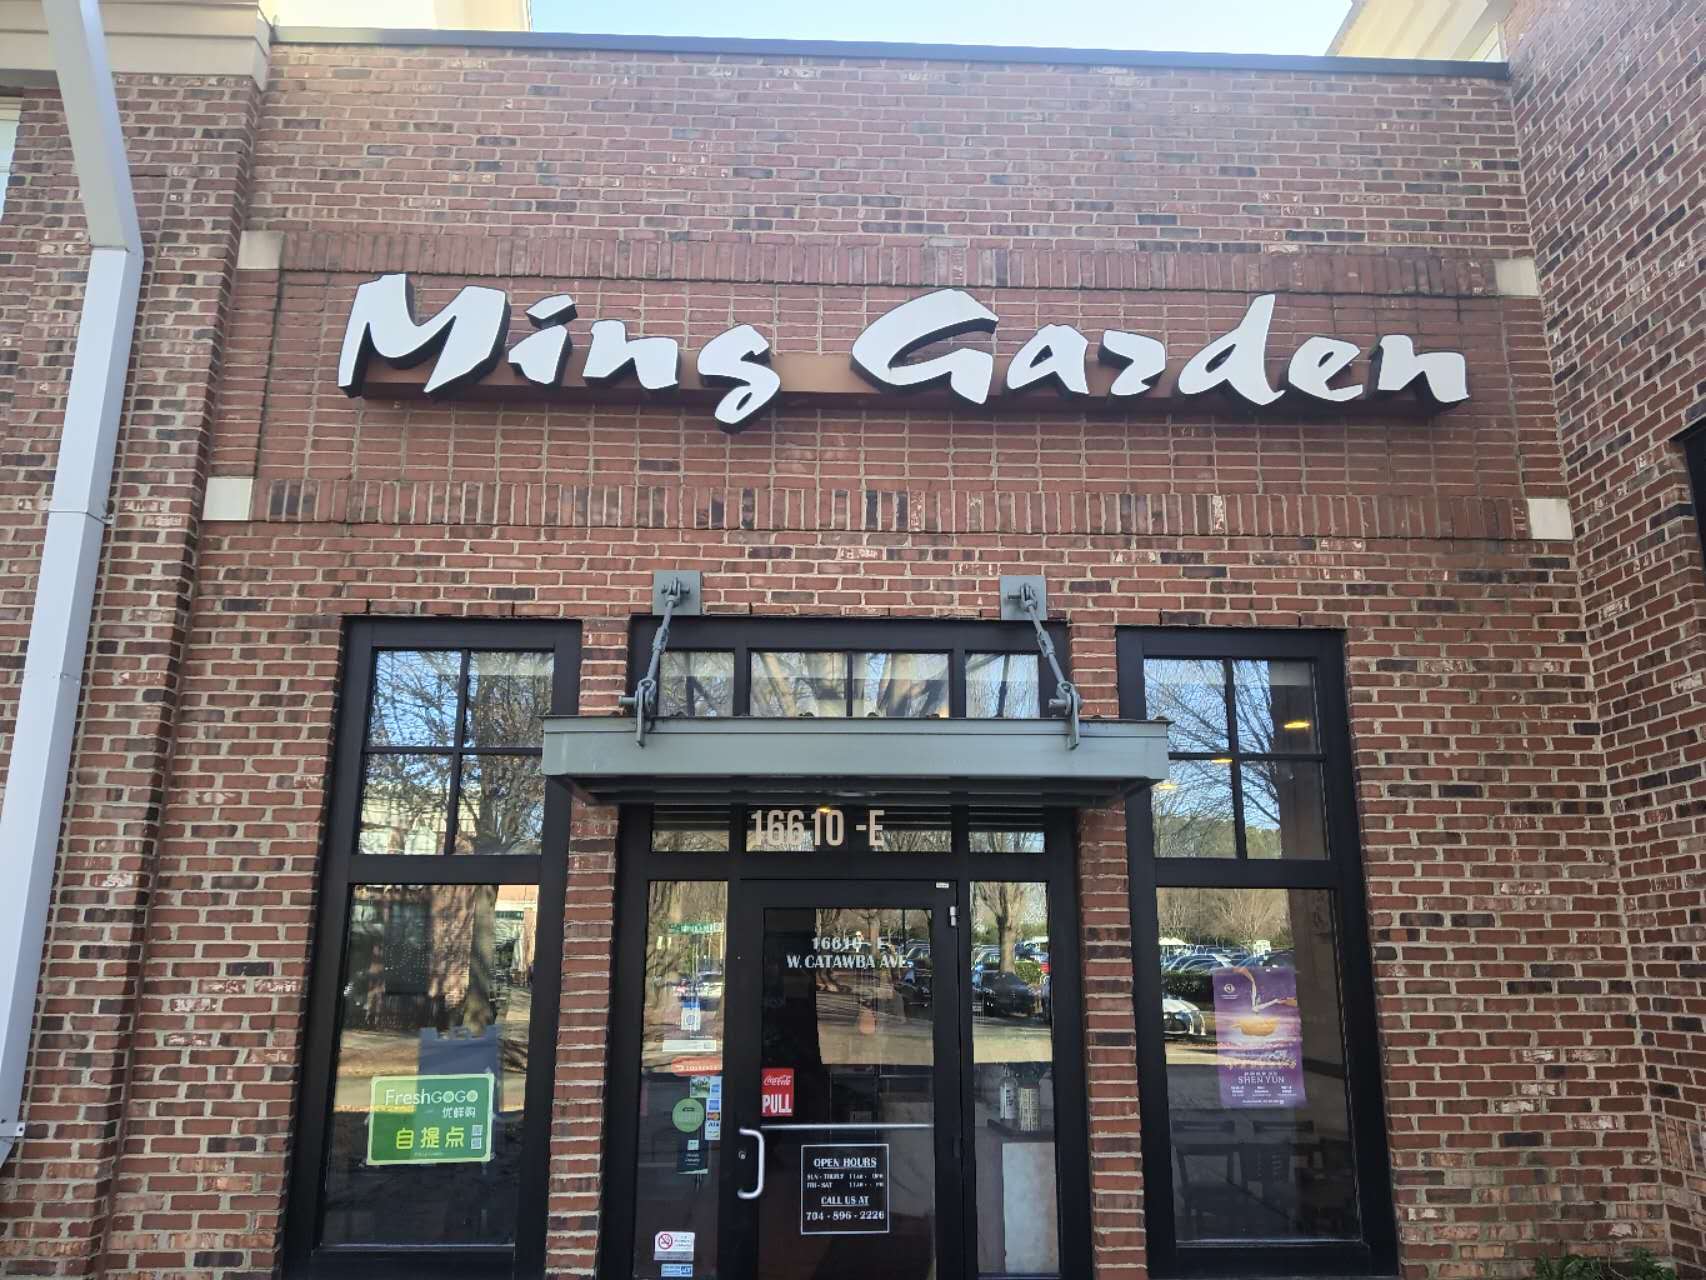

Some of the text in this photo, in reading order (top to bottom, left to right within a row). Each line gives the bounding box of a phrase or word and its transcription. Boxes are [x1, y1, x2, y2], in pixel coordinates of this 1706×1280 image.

[337, 273, 1470, 424] Mins Garden
[751, 808, 844, 846] 16610
[804, 954, 875, 969] CATAWBA
[762, 1094, 792, 1113] PULL
[813, 1157, 877, 1168] OPEN HOURS
[821, 1196, 869, 1205] CALL US AT
